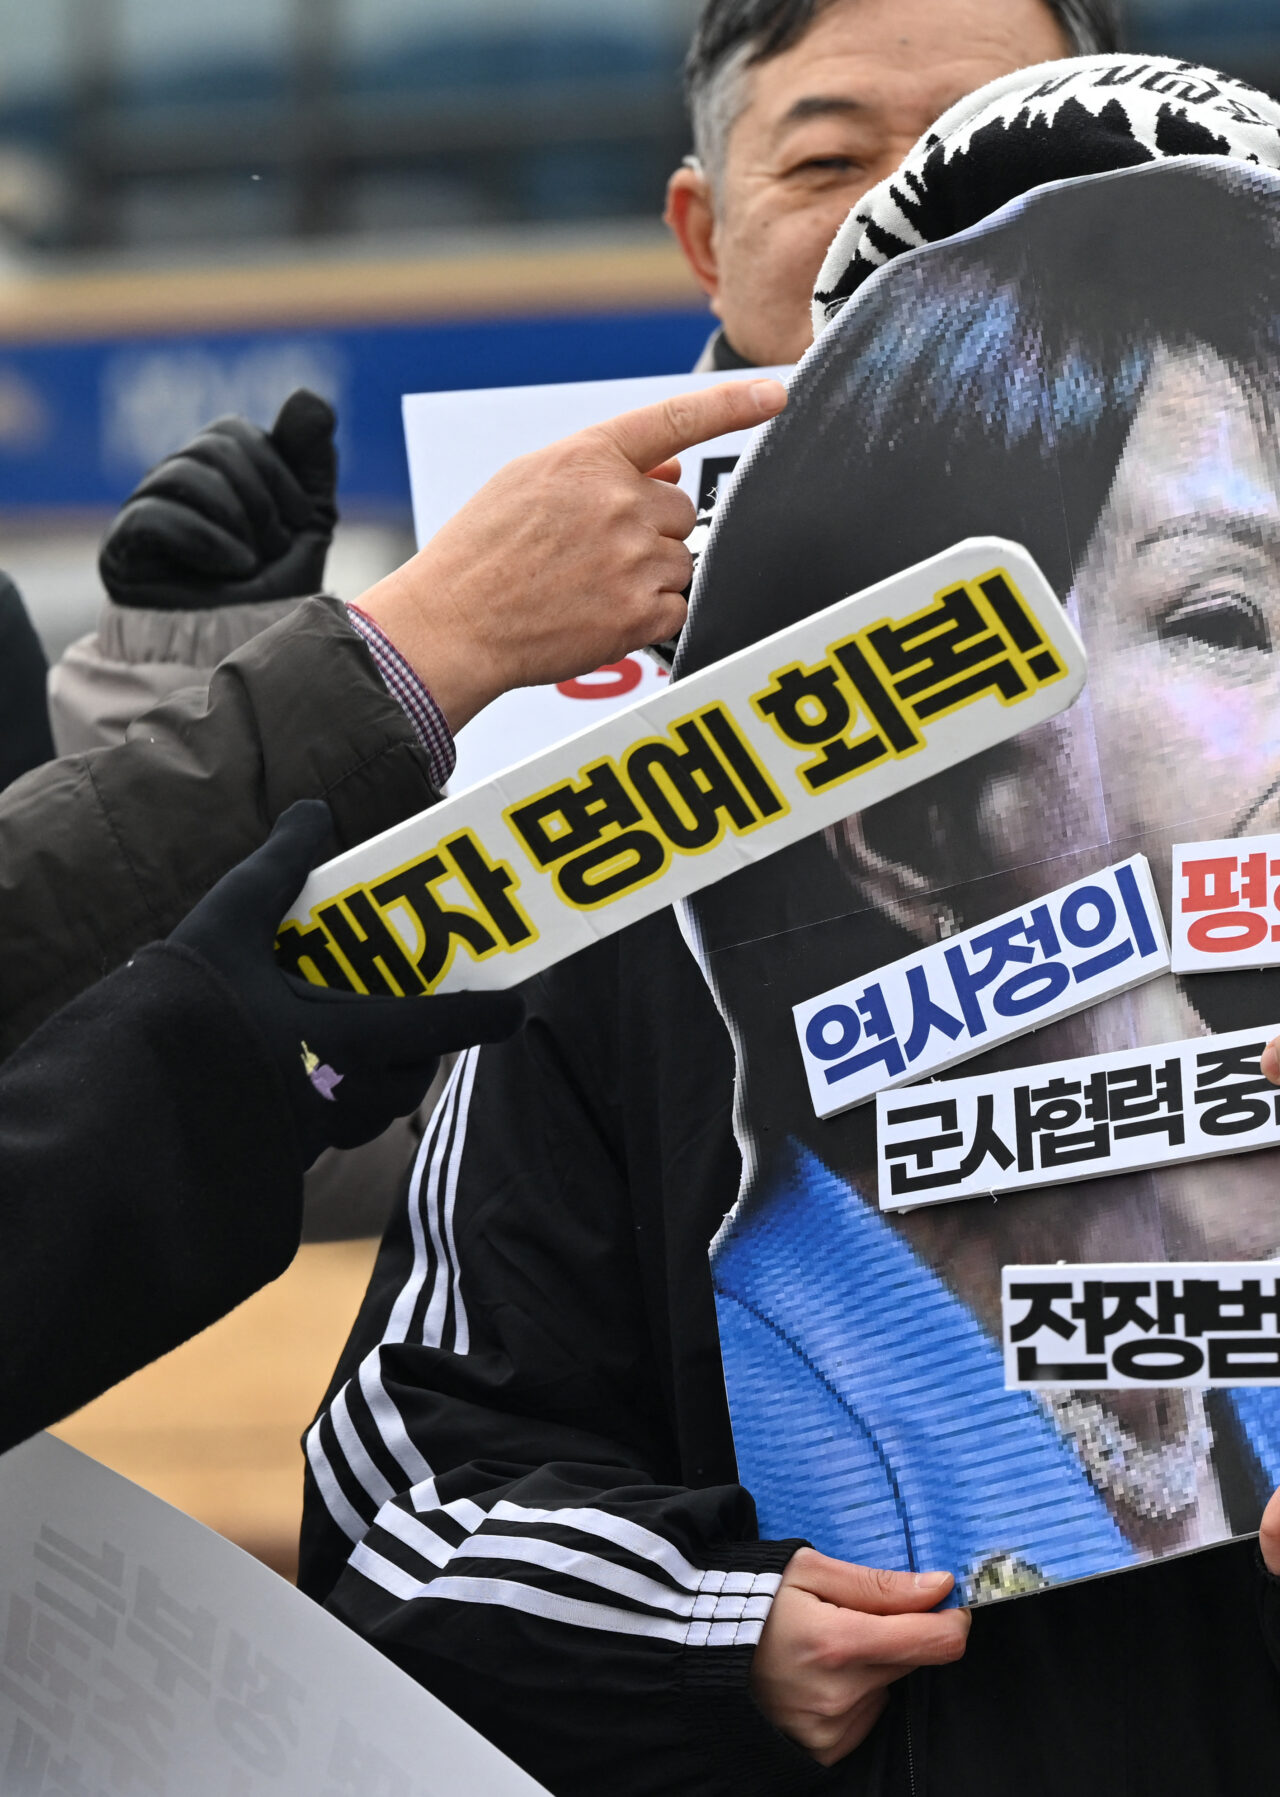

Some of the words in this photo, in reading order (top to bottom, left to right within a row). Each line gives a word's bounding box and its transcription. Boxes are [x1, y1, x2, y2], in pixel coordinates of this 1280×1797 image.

[506, 703, 790, 908] 명예
[754, 569, 1068, 793] 회복!
[805, 864, 1159, 1085] 역사정의
[885, 1057, 1186, 1195] 군사협력
